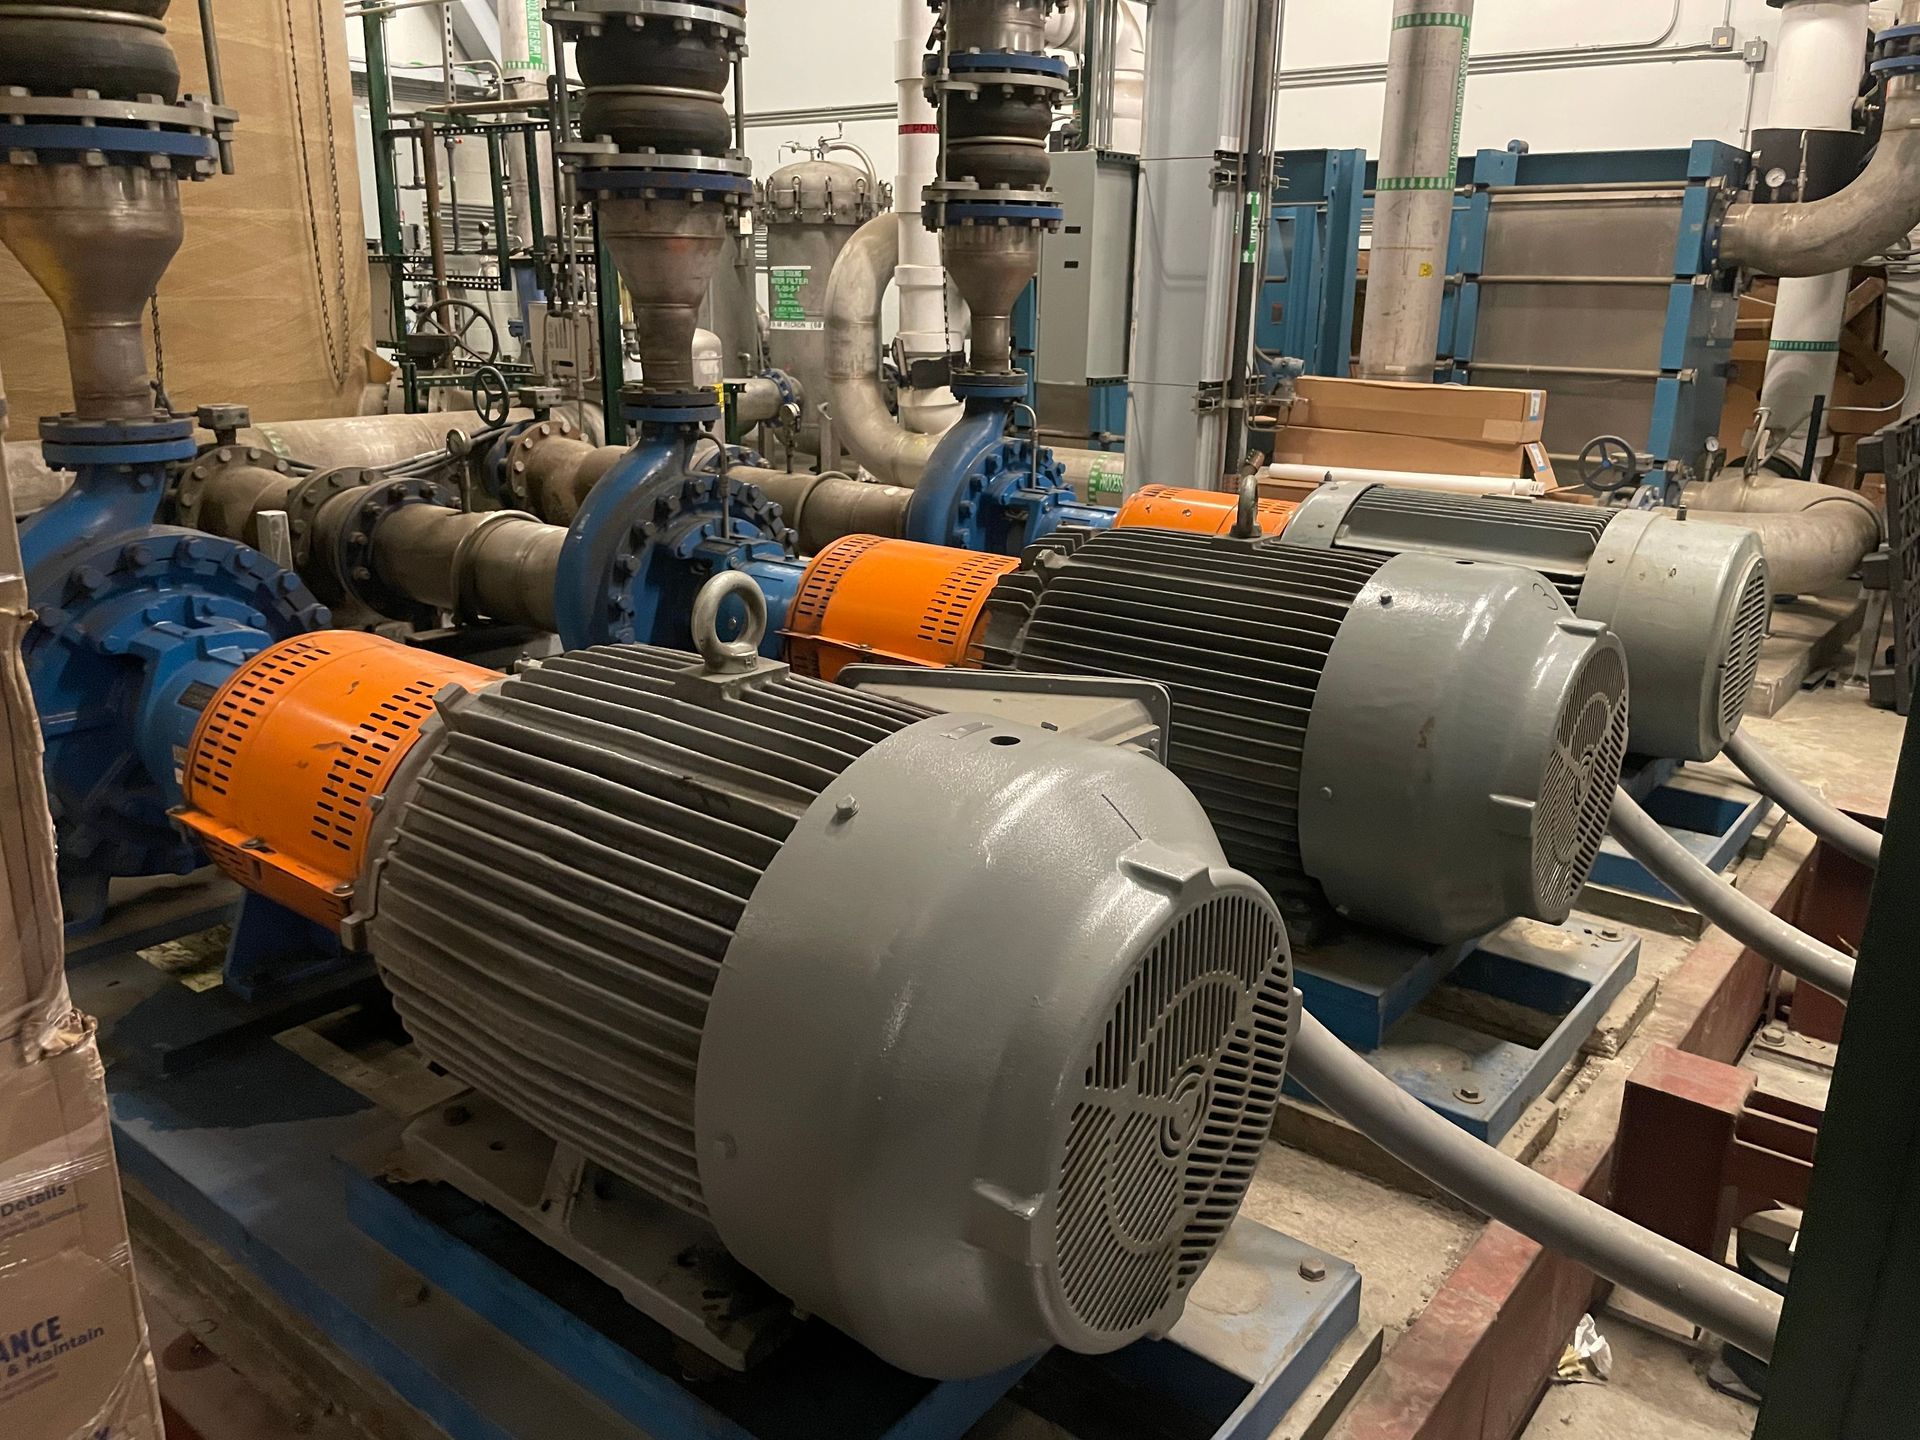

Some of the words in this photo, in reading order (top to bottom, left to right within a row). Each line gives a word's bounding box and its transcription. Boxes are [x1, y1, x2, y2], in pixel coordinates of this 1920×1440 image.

[1250, 215, 1259, 243] VENT
[1, 1184, 67, 1217] Details
[27, 1326, 105, 1367] Maintain
